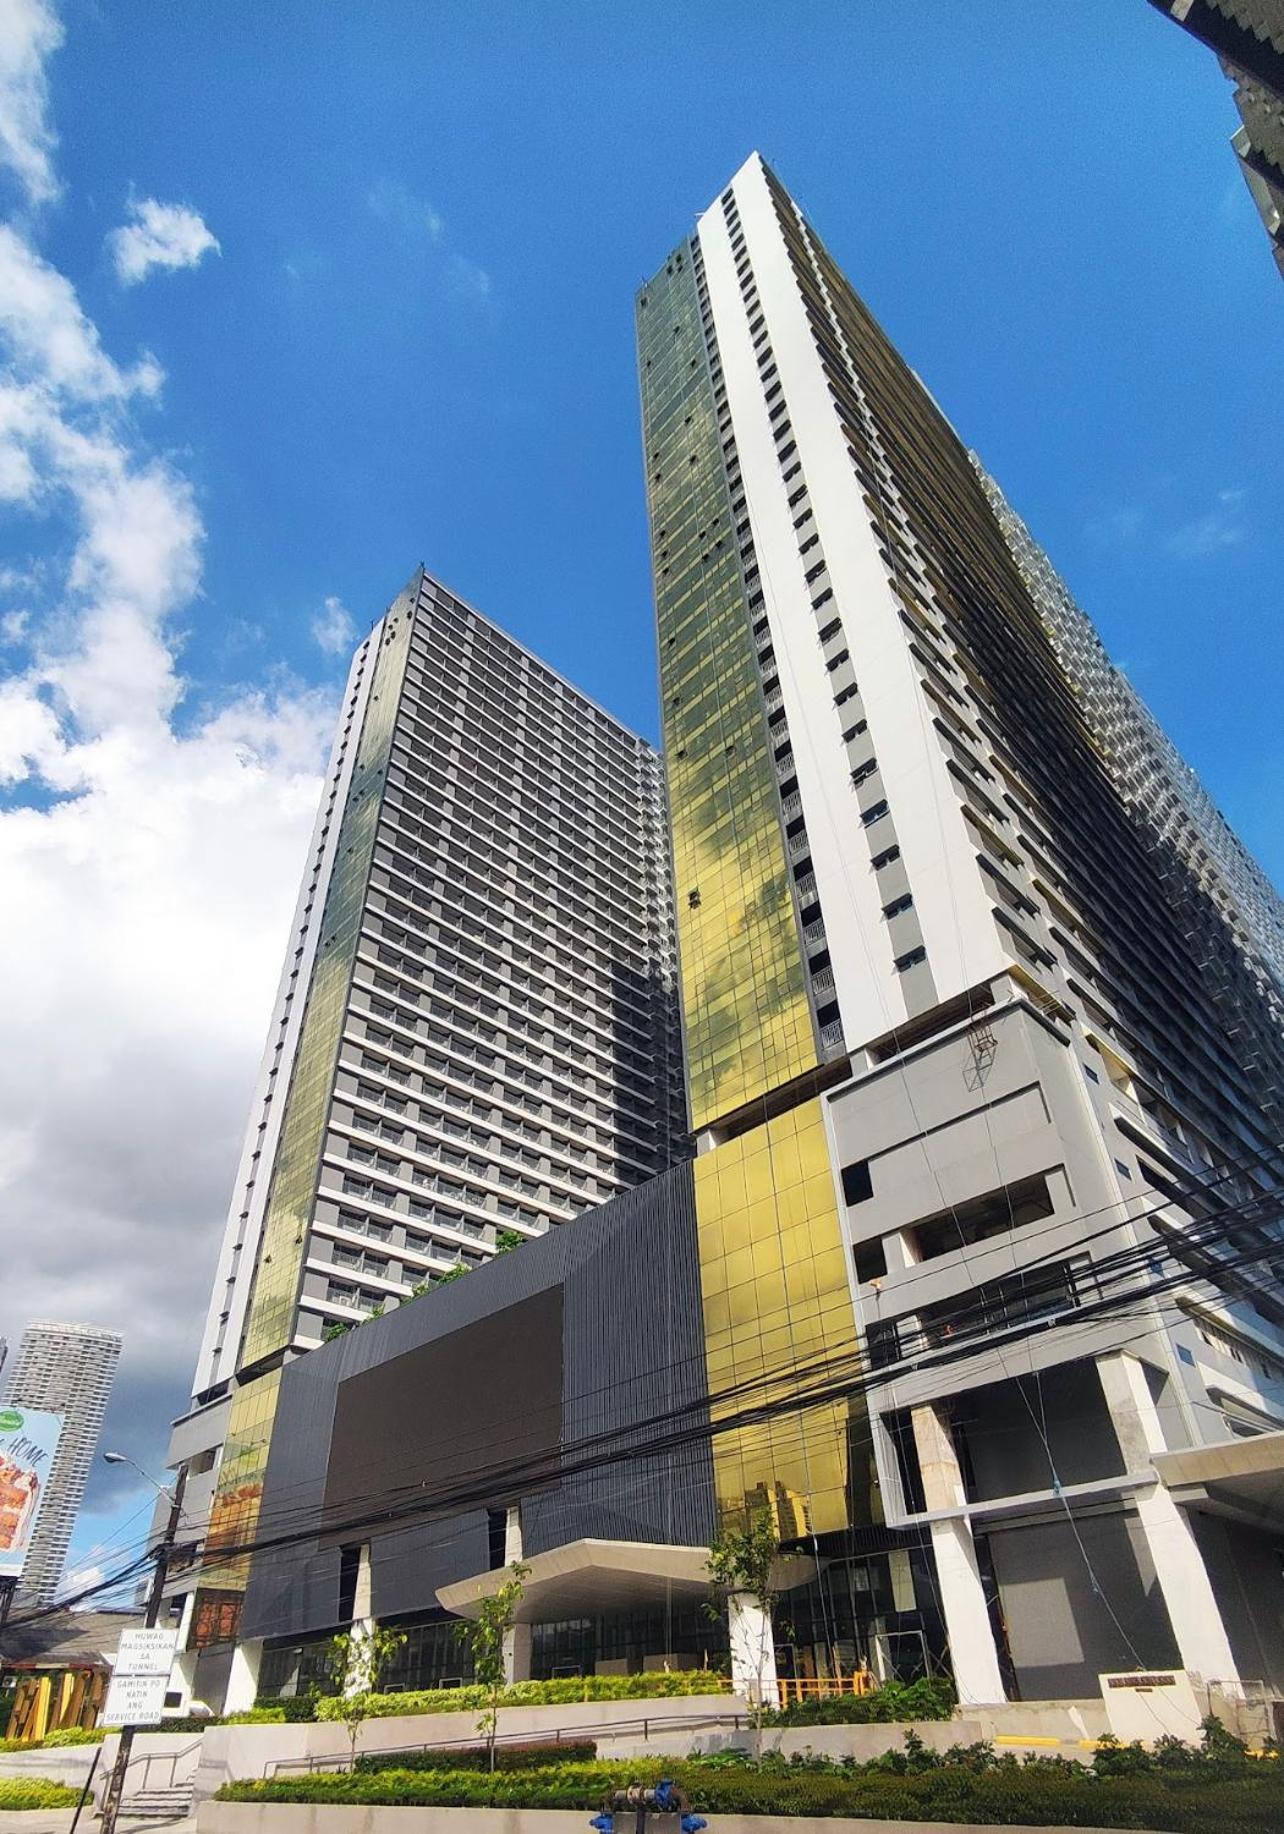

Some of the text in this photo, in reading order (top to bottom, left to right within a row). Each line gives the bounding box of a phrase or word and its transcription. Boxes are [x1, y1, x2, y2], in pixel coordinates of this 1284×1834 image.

[7, 1437, 49, 1467] HOME
[106, 1712, 159, 1721] SERVICE ROAD
